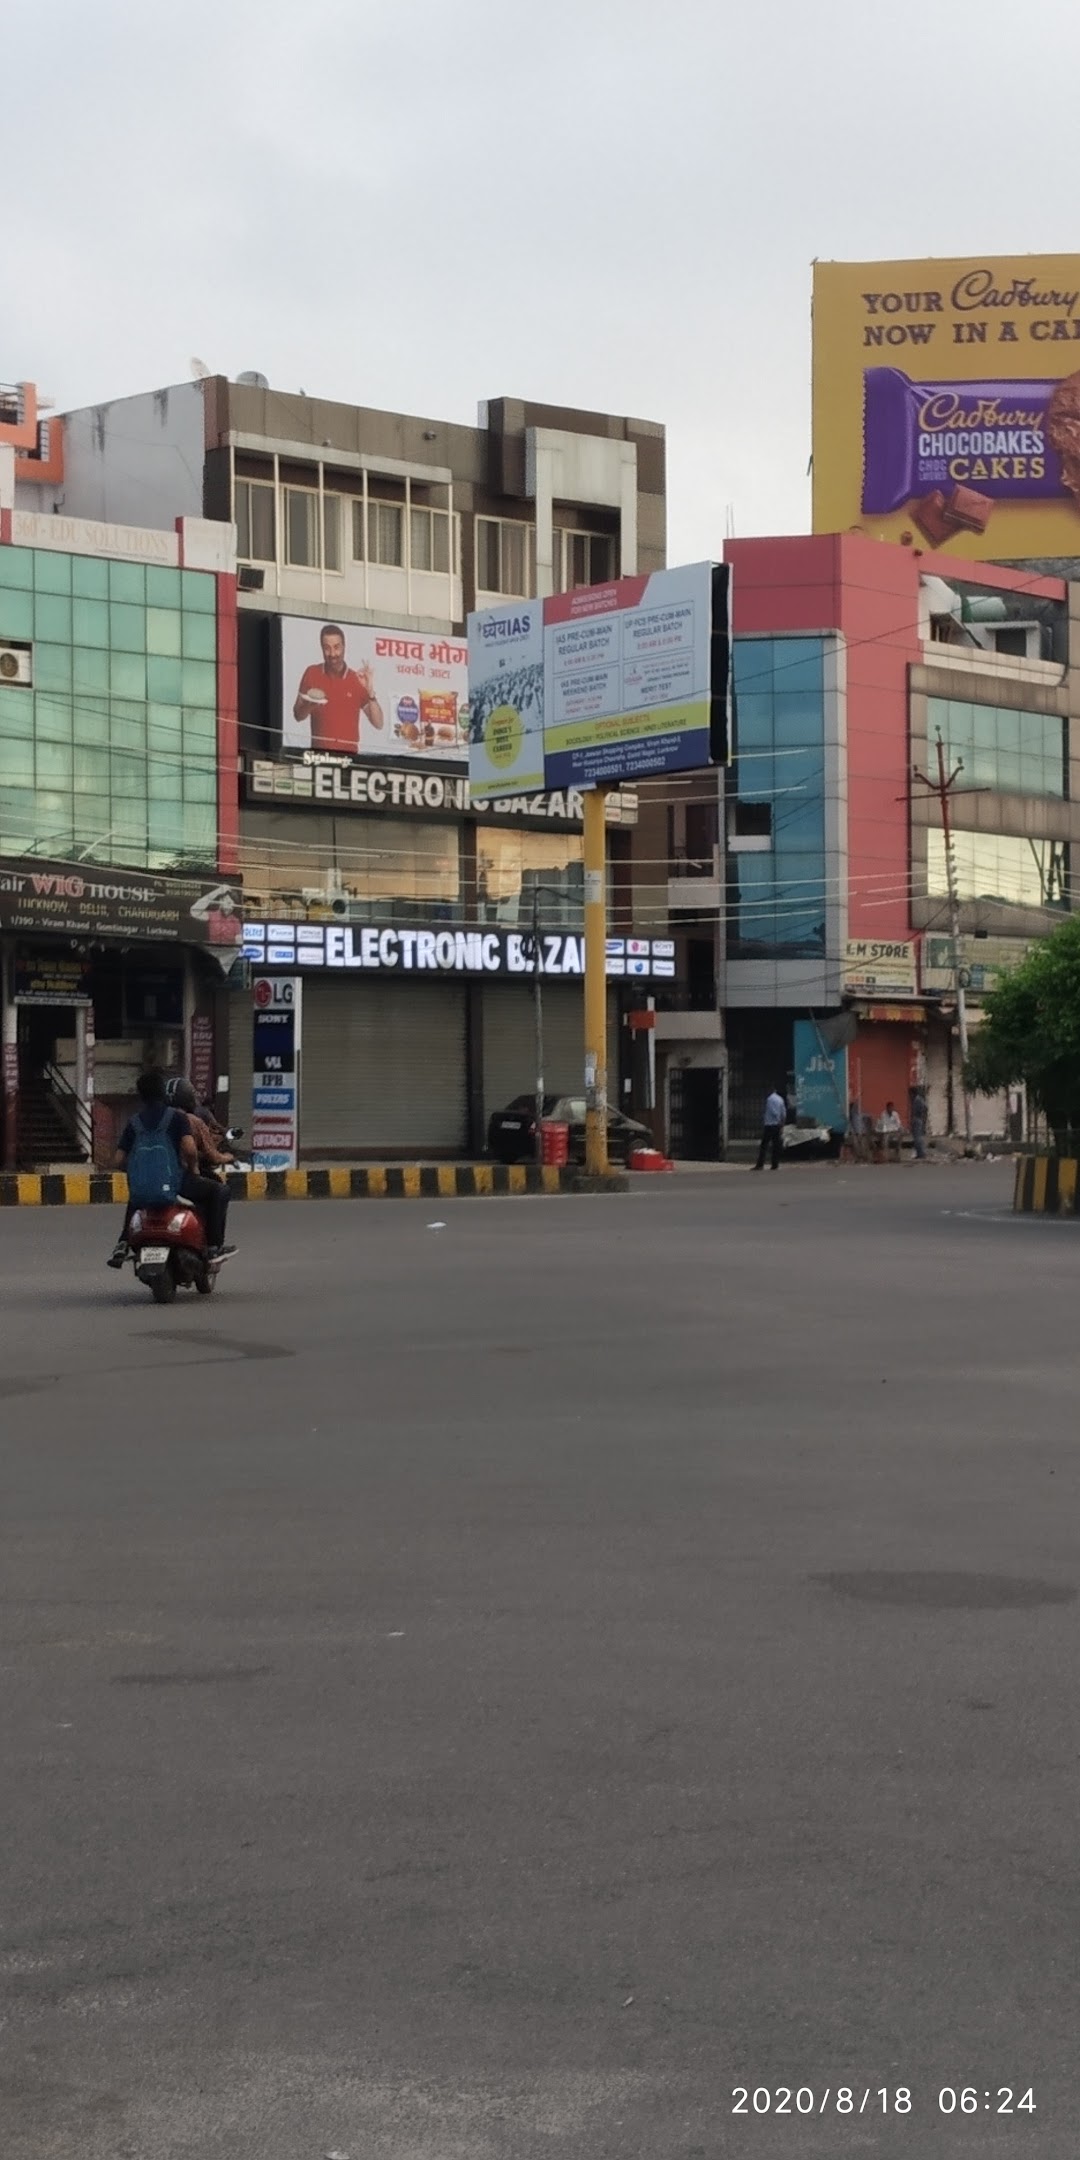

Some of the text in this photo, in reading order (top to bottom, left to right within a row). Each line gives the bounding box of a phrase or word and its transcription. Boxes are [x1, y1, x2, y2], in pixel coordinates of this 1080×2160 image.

[862, 269, 1080, 317] YOUR Cadbury
[863, 323, 936, 346] NOW
[952, 321, 988, 344] IN
[998, 321, 1019, 342] A
[919, 391, 1043, 436] Cadbury
[919, 430, 1045, 457] CHOCOBAKES
[949, 457, 1045, 480] CAKES
[633, 620, 683, 638] REGULAR BATCH
[375, 636, 424, 661] राघव
[428, 640, 469, 666] भोग
[558, 636, 610, 655] REGULAR BATCH
[430, 667, 451, 679] आटा
[0, 876, 25, 892] air
[31, 872, 84, 898] WIG
[91, 883, 156, 903] HOUSE
[326, 925, 500, 972] ELECTRONIC
[870, 943, 909, 959] STORE
[273, 983, 293, 1004] LG
[257, 1014, 289, 1024] SONY
[805, 1054, 836, 1072] Jio
